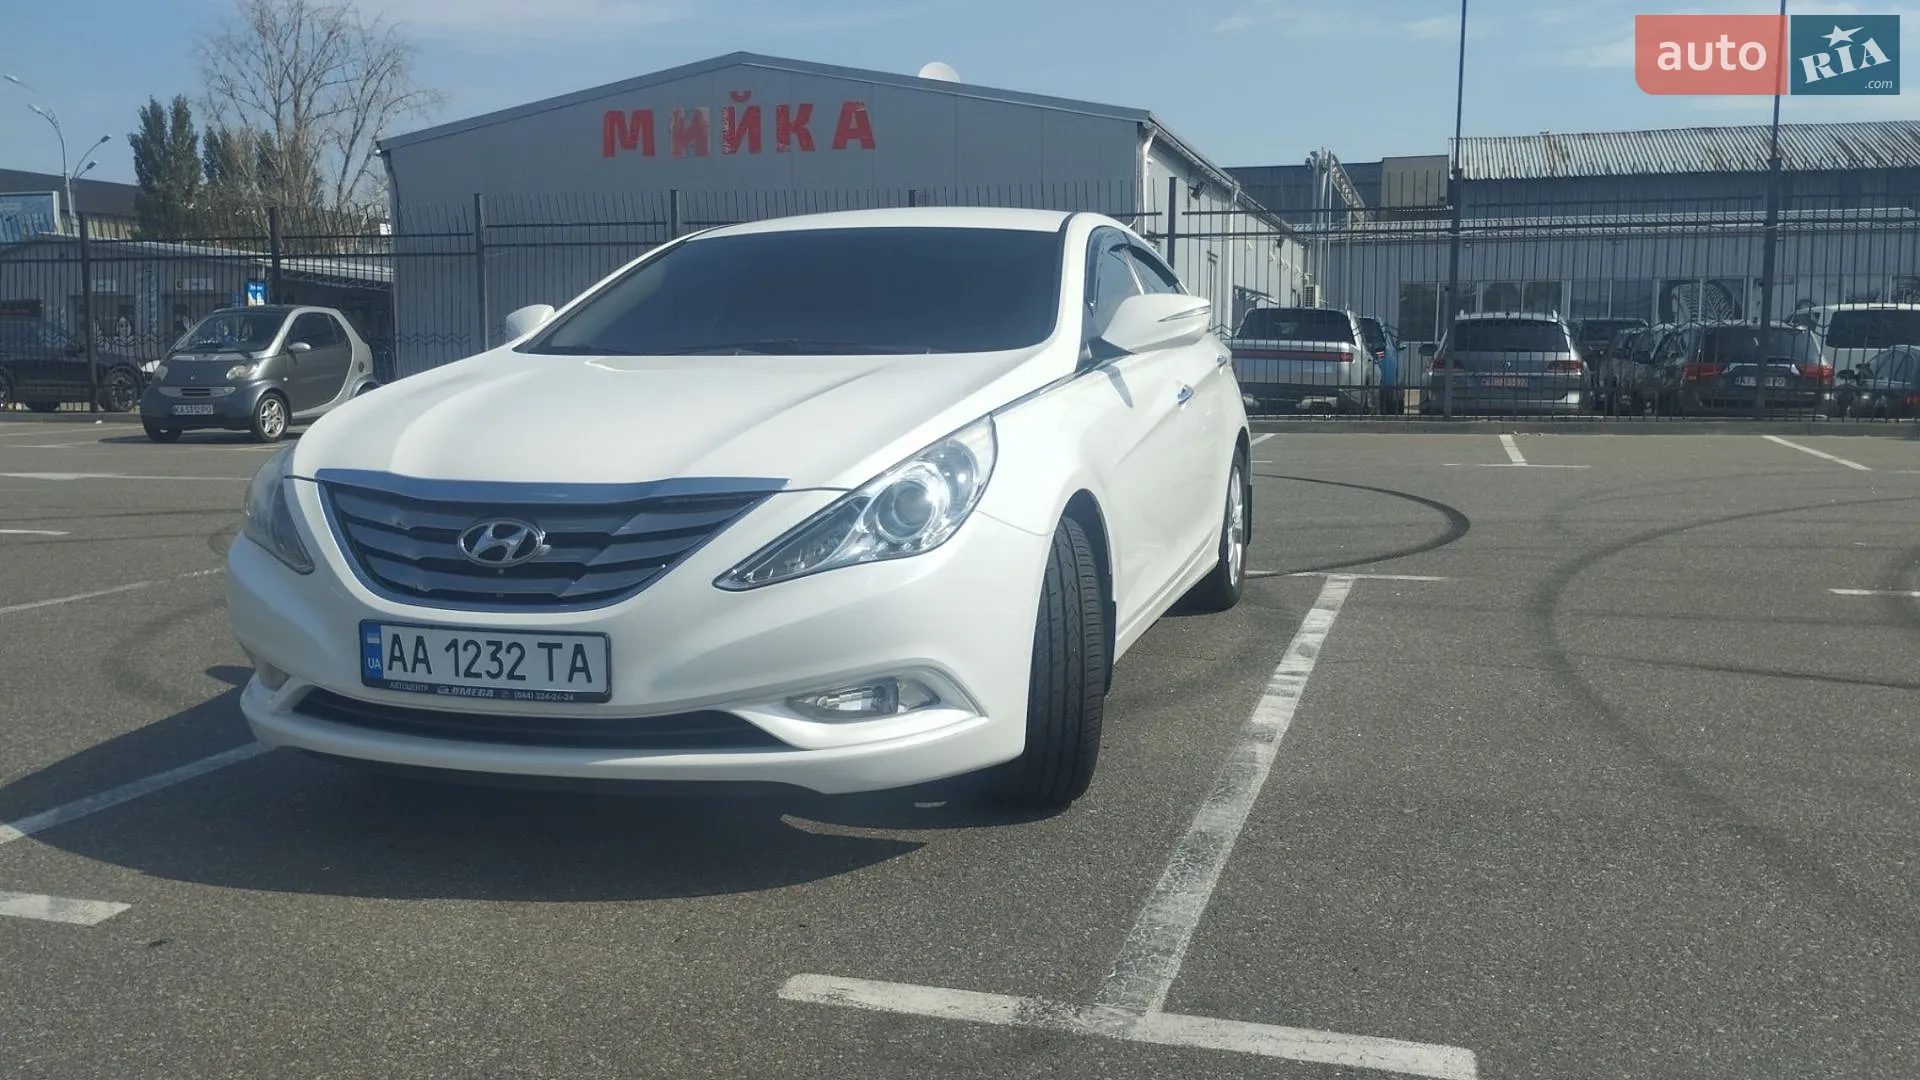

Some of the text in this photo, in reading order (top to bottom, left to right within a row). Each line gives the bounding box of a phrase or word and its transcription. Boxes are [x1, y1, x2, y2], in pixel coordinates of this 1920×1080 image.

[603, 90, 876, 158] МИЙКА
[367, 657, 382, 670] UA
[388, 633, 593, 684] AA 1232 TA
